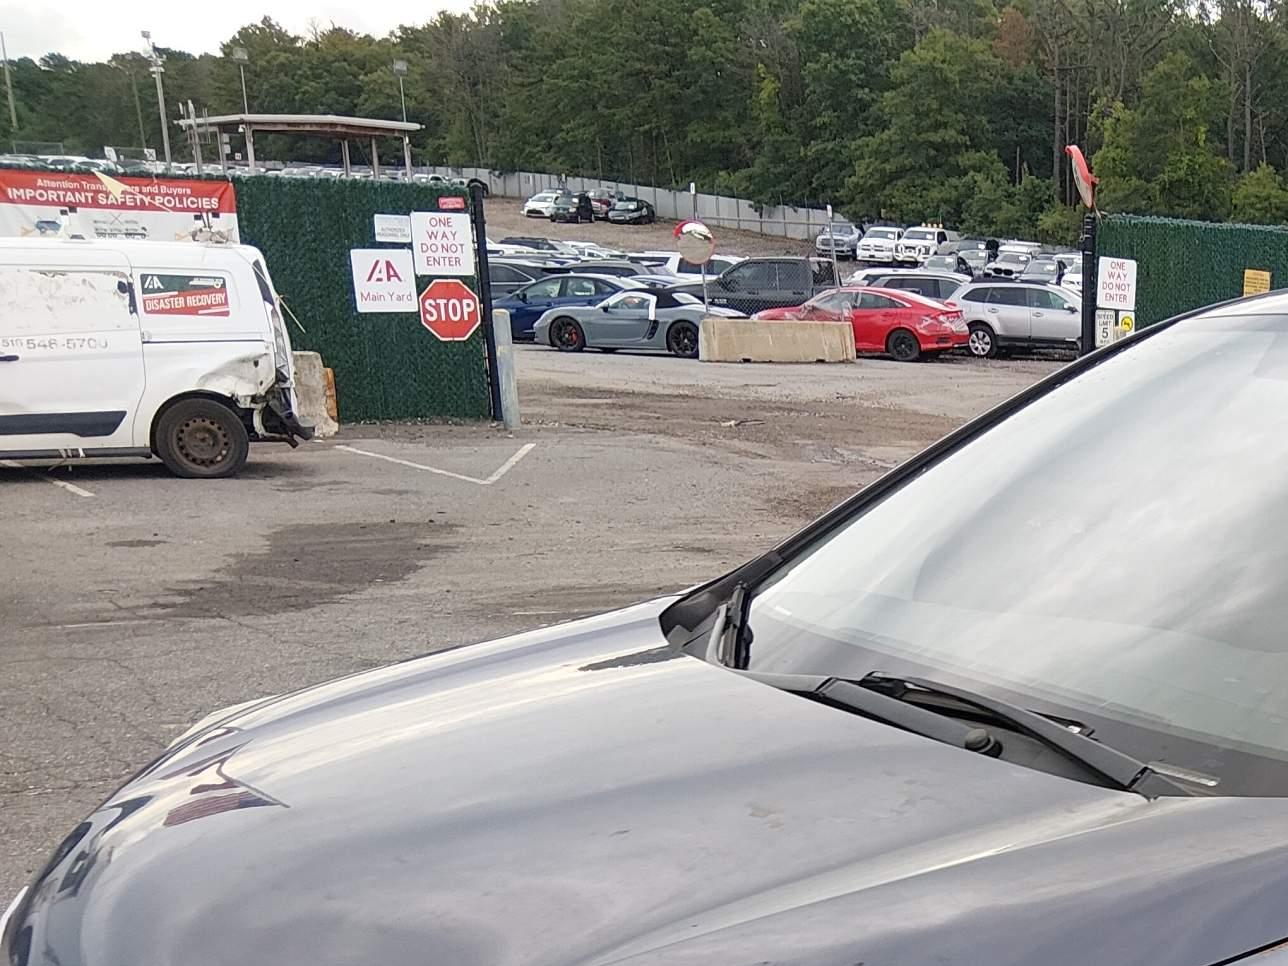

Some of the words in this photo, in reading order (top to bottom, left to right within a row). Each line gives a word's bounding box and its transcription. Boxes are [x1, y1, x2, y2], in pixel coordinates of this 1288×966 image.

[36, 178, 80, 189] Attention
[81, 180, 140, 193] Transers
[142, 184, 158, 193] and
[160, 185, 191, 196] Buyers
[7, 187, 93, 204] IMPORTANT
[98, 193, 152, 207] SAFETY
[155, 196, 219, 210] POLICIES
[429, 217, 452, 227] ONE
[427, 231, 457, 240] WAY
[421, 243, 438, 253] DO
[441, 243, 465, 254] NOT
[426, 256, 461, 267] ENTER
[1110, 261, 1126, 271] ONE
[1107, 271, 1128, 281] WAY
[1102, 282, 1114, 290] DO
[1115, 283, 1131, 291] NOT
[360, 291, 385, 301] Main
[388, 291, 412, 301] Yard
[1105, 293, 1127, 303] ENTER
[145, 296, 185, 311] DISASTER
[186, 292, 226, 308] RECOVERY
[424, 298, 475, 322] STOP
[1102, 327, 1109, 339] 5
